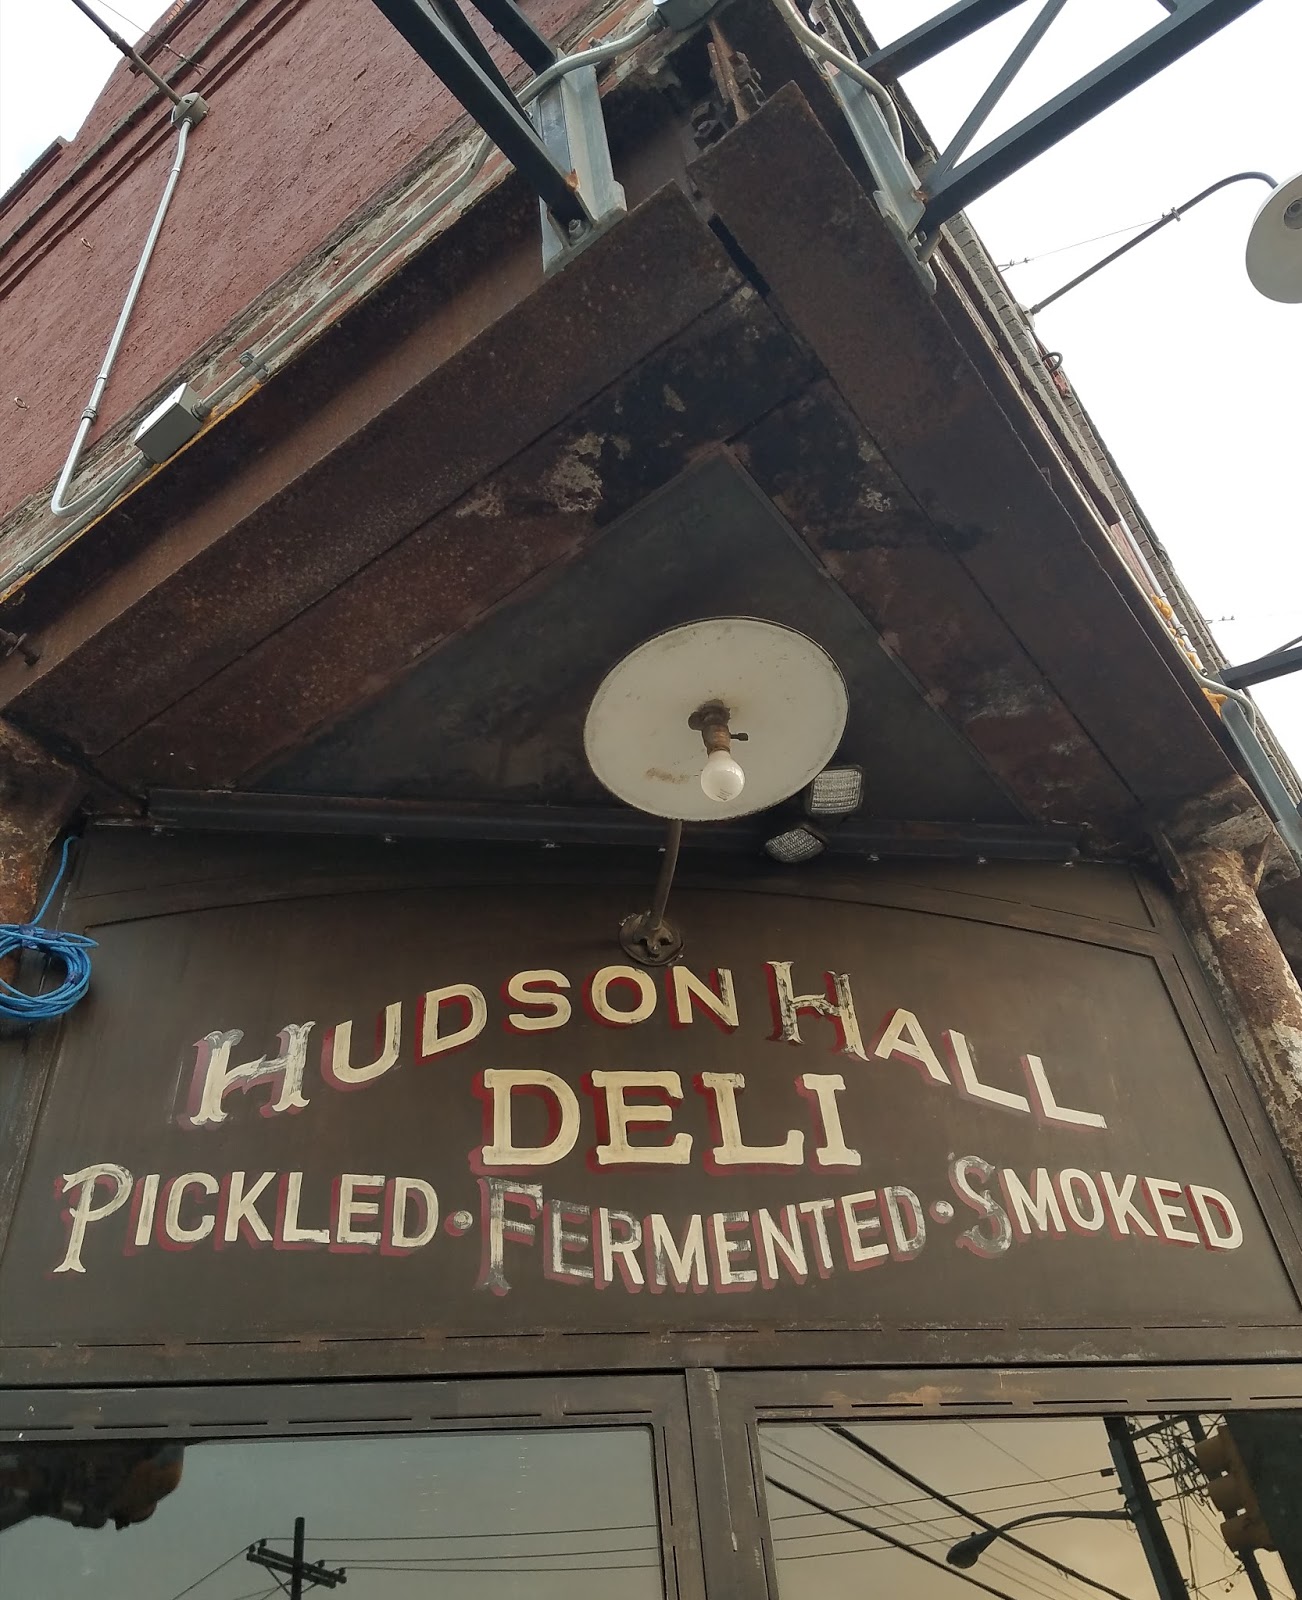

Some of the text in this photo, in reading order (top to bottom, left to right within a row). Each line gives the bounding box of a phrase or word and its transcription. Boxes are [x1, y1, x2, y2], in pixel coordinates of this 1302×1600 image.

[184, 960, 1108, 1129] HUDSON HALL
[476, 1068, 862, 1170] DELI
[52, 1152, 1244, 1295] PICKLED FERMENTED SMOKED
